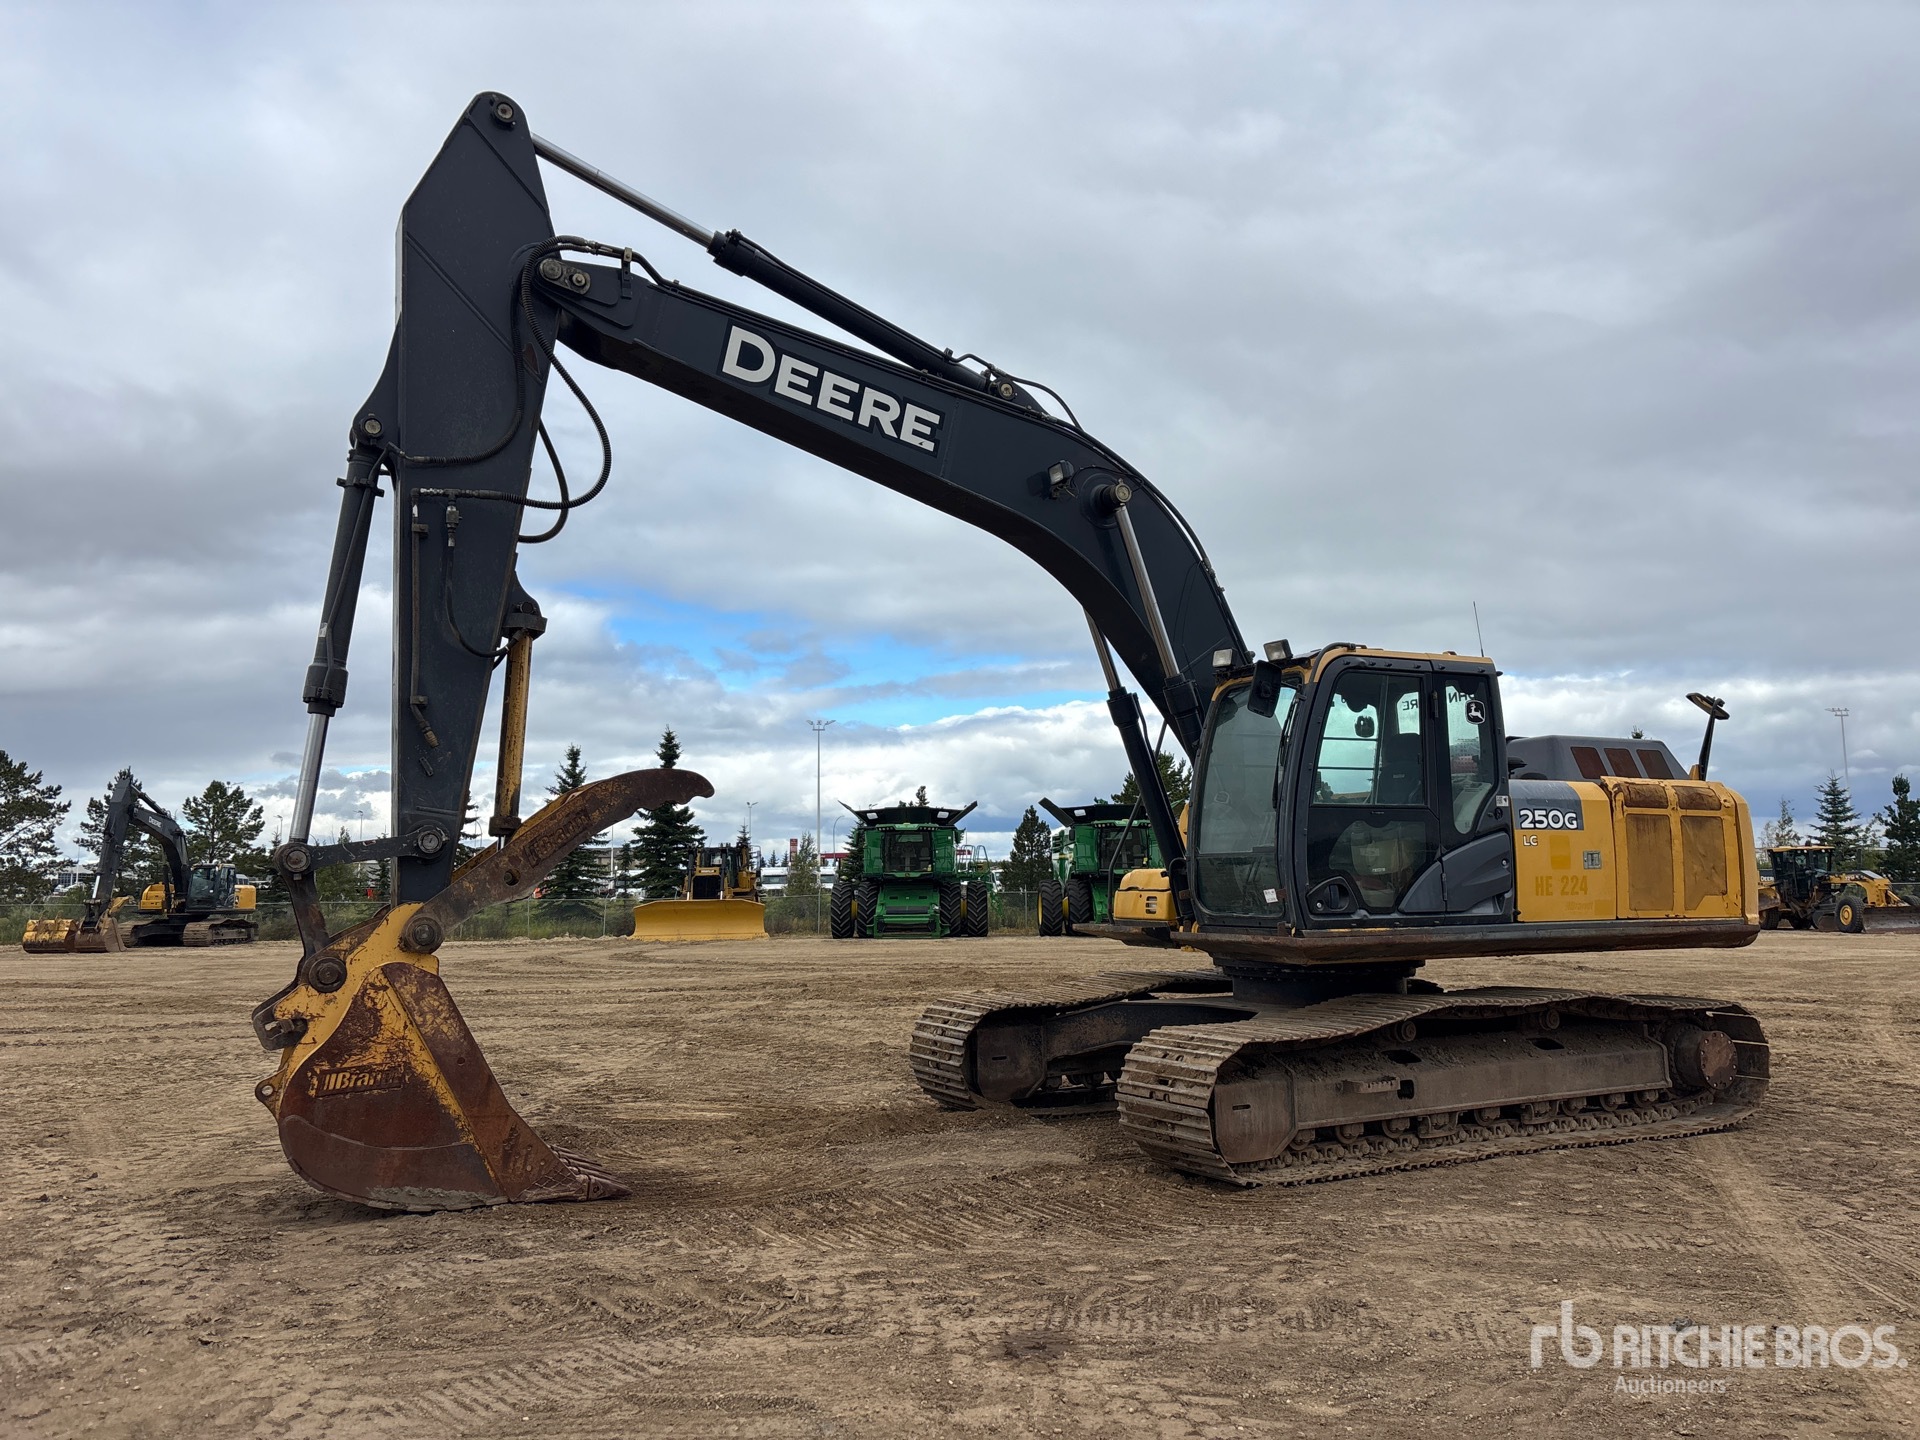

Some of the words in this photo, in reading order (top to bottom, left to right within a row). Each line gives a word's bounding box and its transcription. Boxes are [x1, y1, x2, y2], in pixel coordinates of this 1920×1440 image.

[721, 325, 941, 452] DEERE
[1519, 809, 1578, 829] 250G
[1523, 835, 1538, 846] LC
[1535, 876, 1553, 896] HE
[1560, 875, 1588, 896] 224
